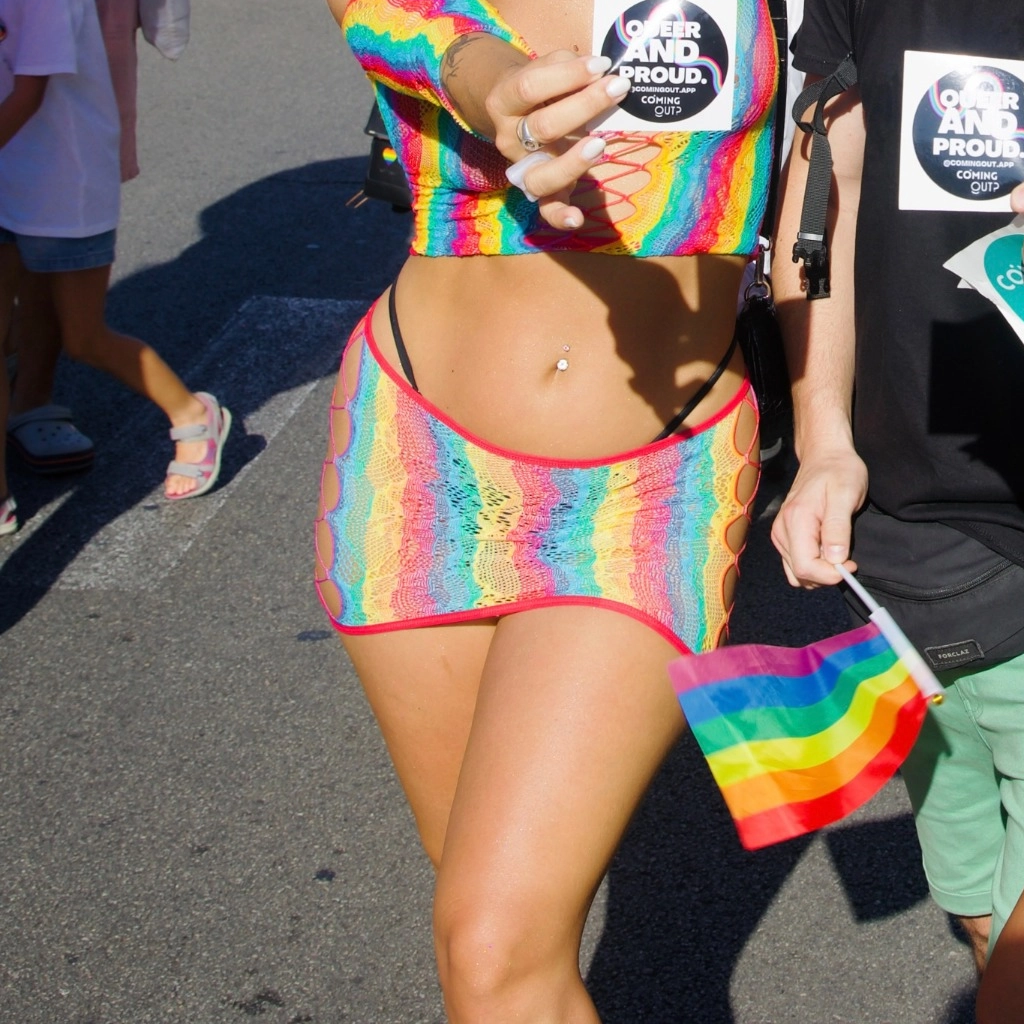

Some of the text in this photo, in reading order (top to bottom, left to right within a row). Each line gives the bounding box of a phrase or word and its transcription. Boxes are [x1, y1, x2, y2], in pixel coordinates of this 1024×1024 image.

[623, 38, 700, 64] AND
[619, 66, 708, 85] PROUD.
[632, 86, 697, 94] COMINGOUT.APP
[938, 108, 1018, 138] AND
[943, 159, 1015, 168] @COMINGOUT.APP
[937, 649, 970, 660] FORCLAZ
